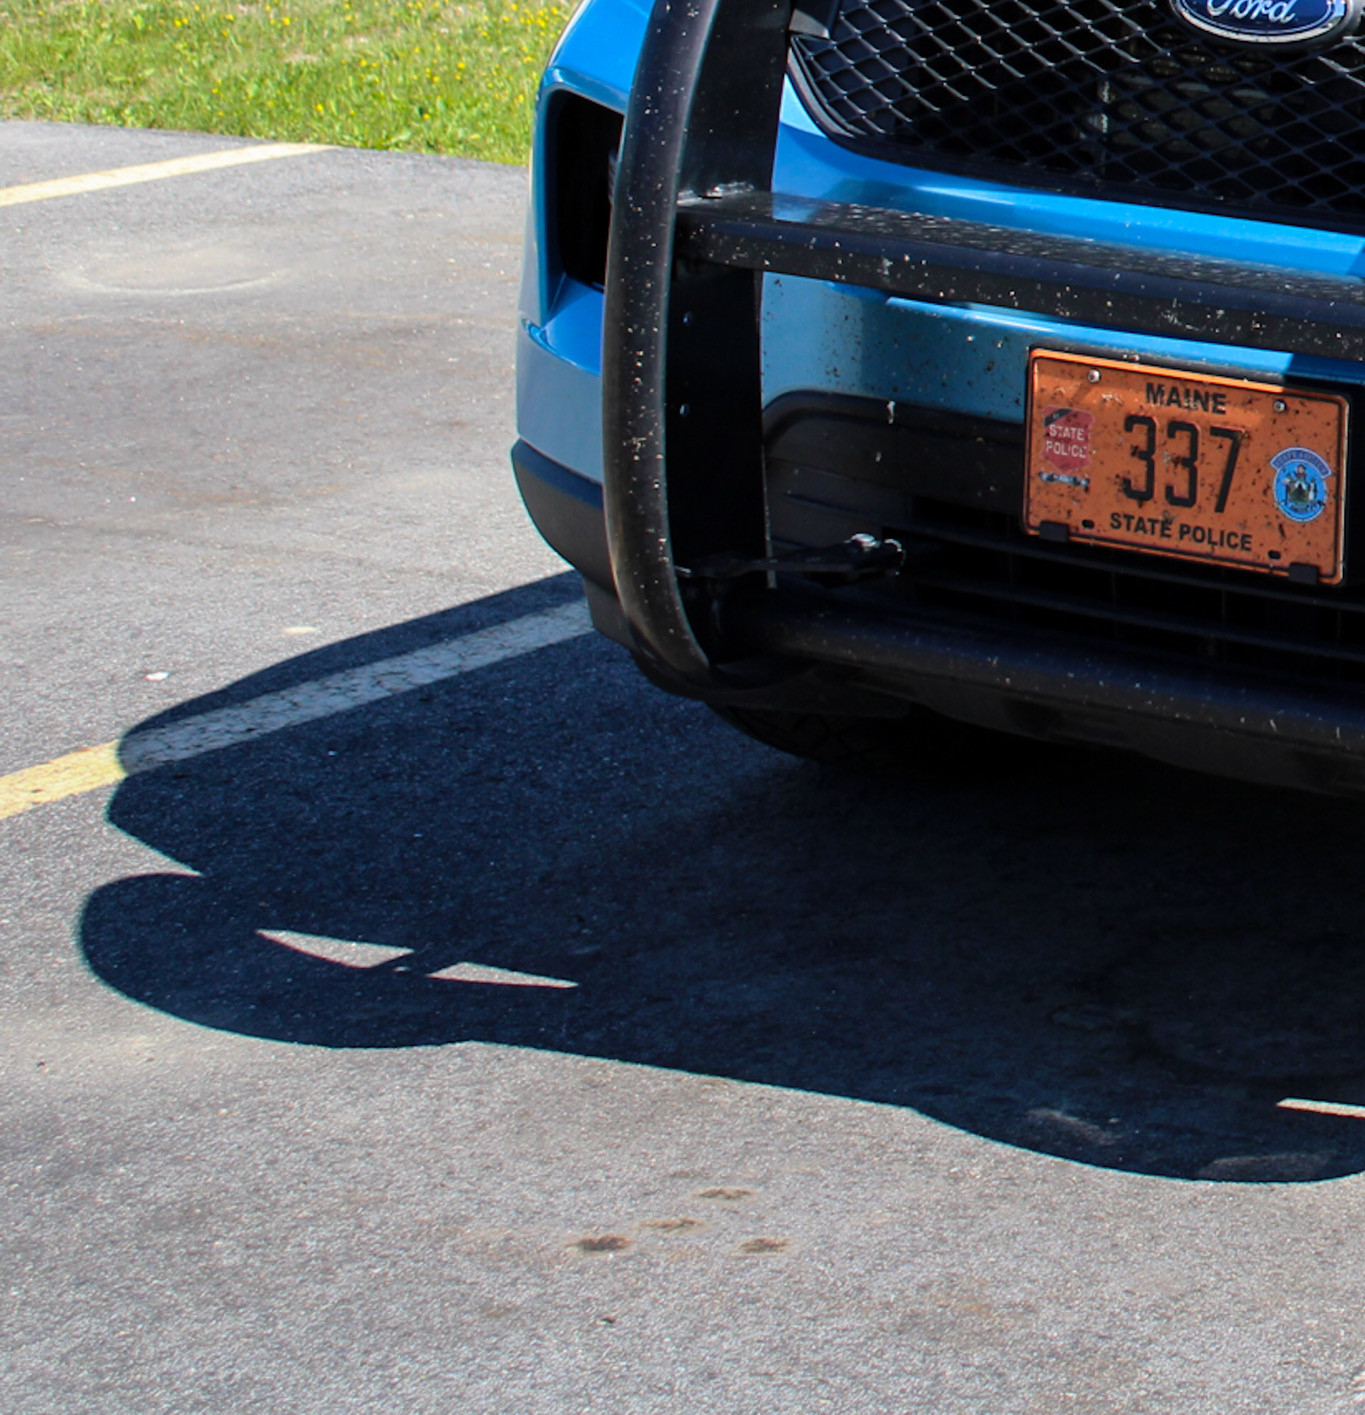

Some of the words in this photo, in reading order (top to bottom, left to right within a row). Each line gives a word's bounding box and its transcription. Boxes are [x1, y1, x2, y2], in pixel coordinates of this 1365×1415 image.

[1145, 382, 1228, 416] MAINE
[1045, 440, 1088, 459] POLICE
[1048, 423, 1086, 442] STATE
[1123, 414, 1247, 514] 337
[1109, 512, 1173, 540] STATE
[1179, 522, 1253, 552] POLICE
